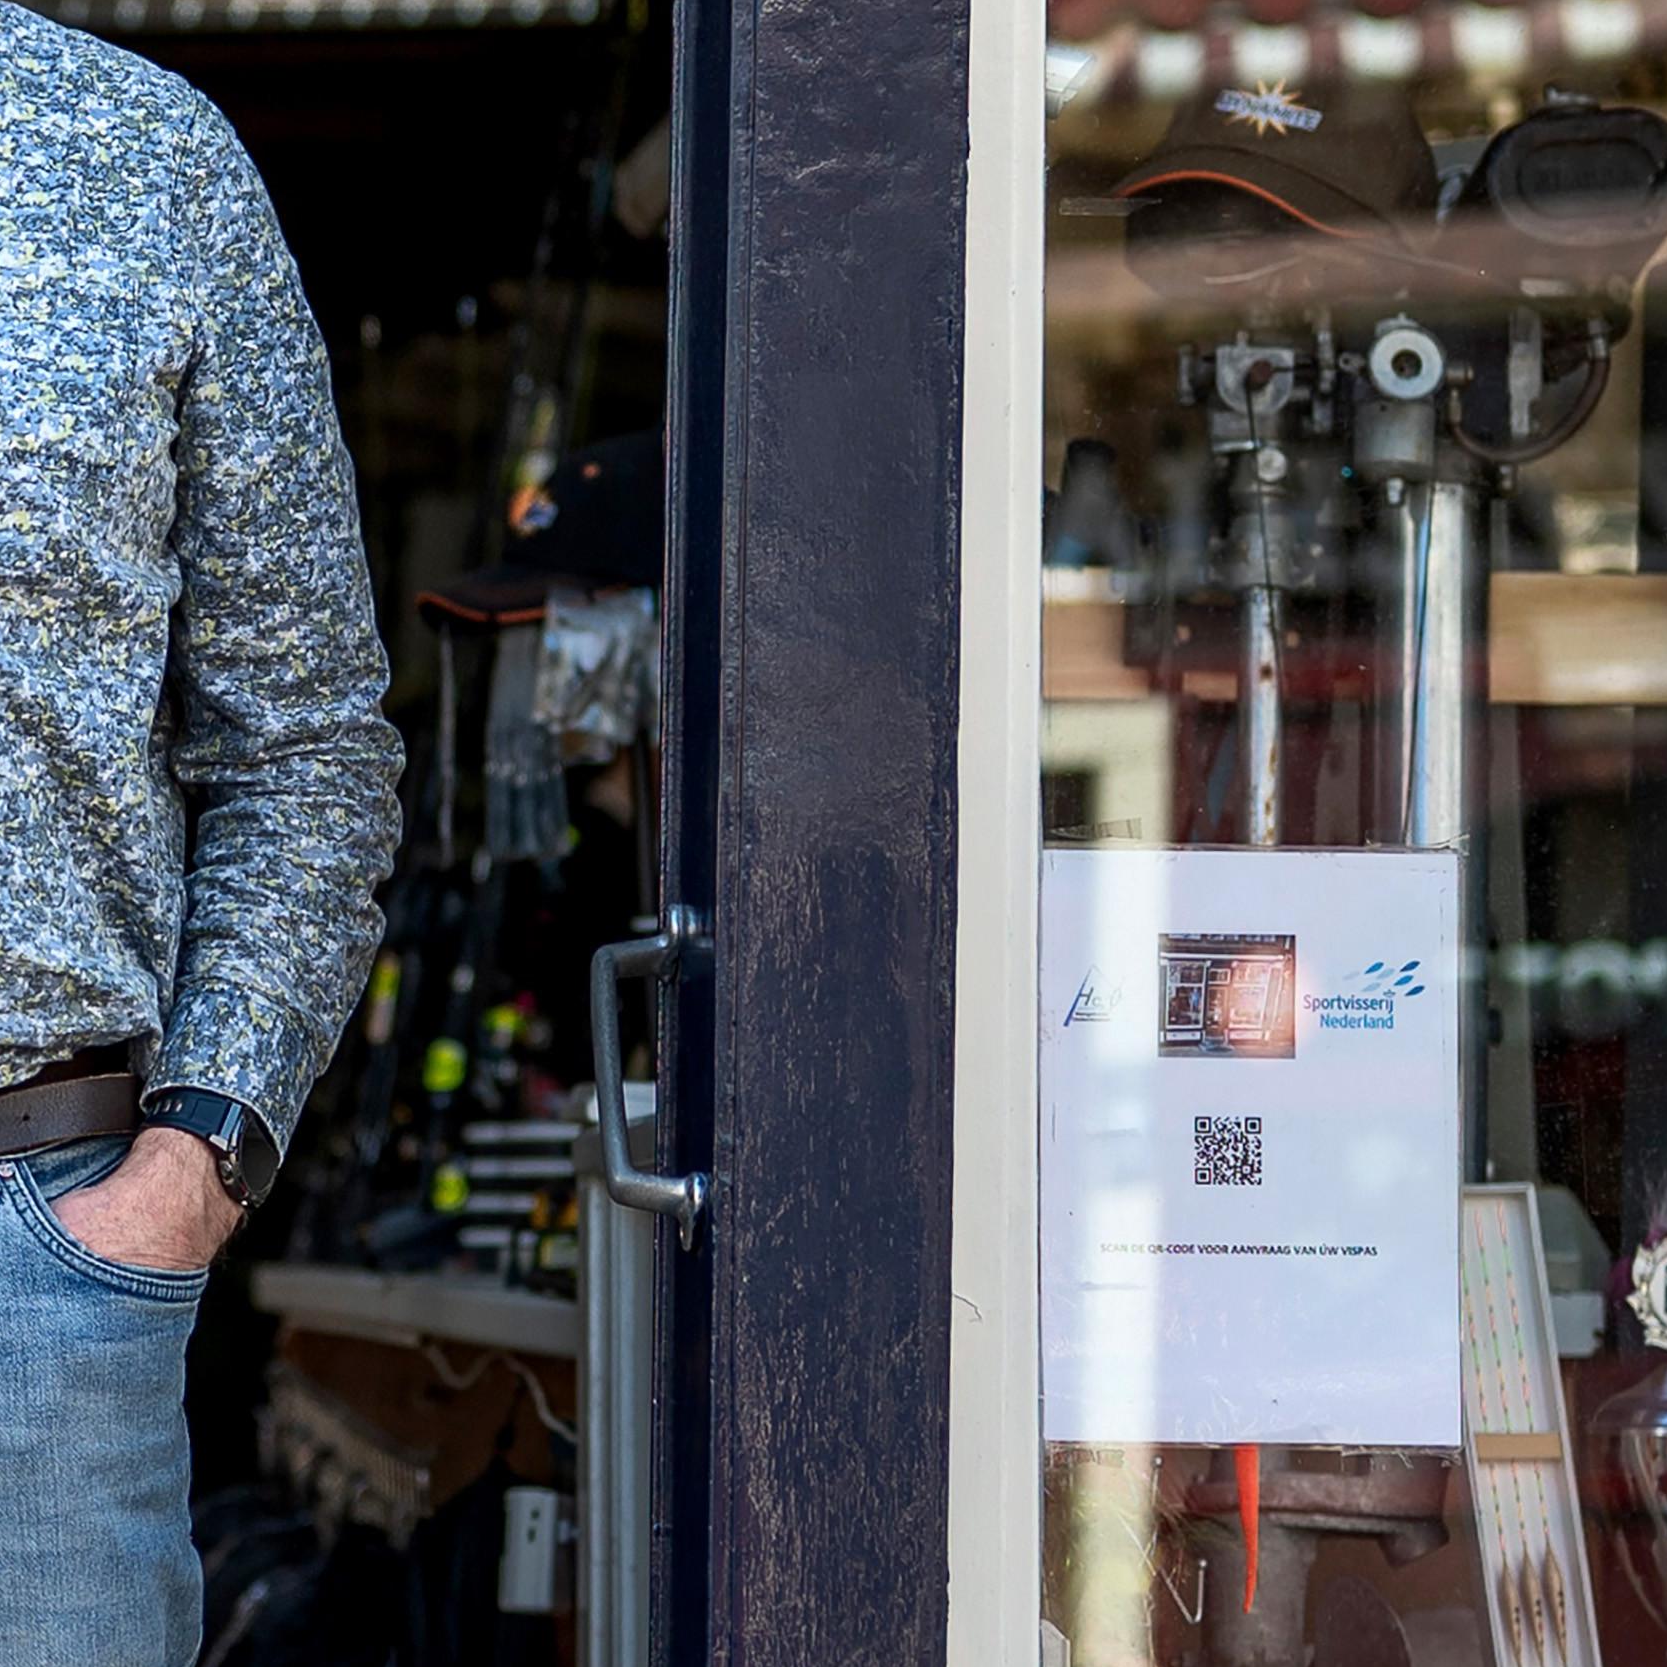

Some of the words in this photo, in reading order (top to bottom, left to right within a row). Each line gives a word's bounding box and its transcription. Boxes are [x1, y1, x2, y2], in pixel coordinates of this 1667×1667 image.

[1303, 991, 1394, 1015] Sportvisserij
[1320, 1013, 1394, 1029] Nederland
[1148, 1244, 1196, 1255] QR-CODE
[1198, 1244, 1229, 1255] VOOR
[1231, 1245, 1291, 1256] AANVRAAG
[1294, 1246, 1317, 1256] VAN
[1341, 1246, 1379, 1257] VISPAS
